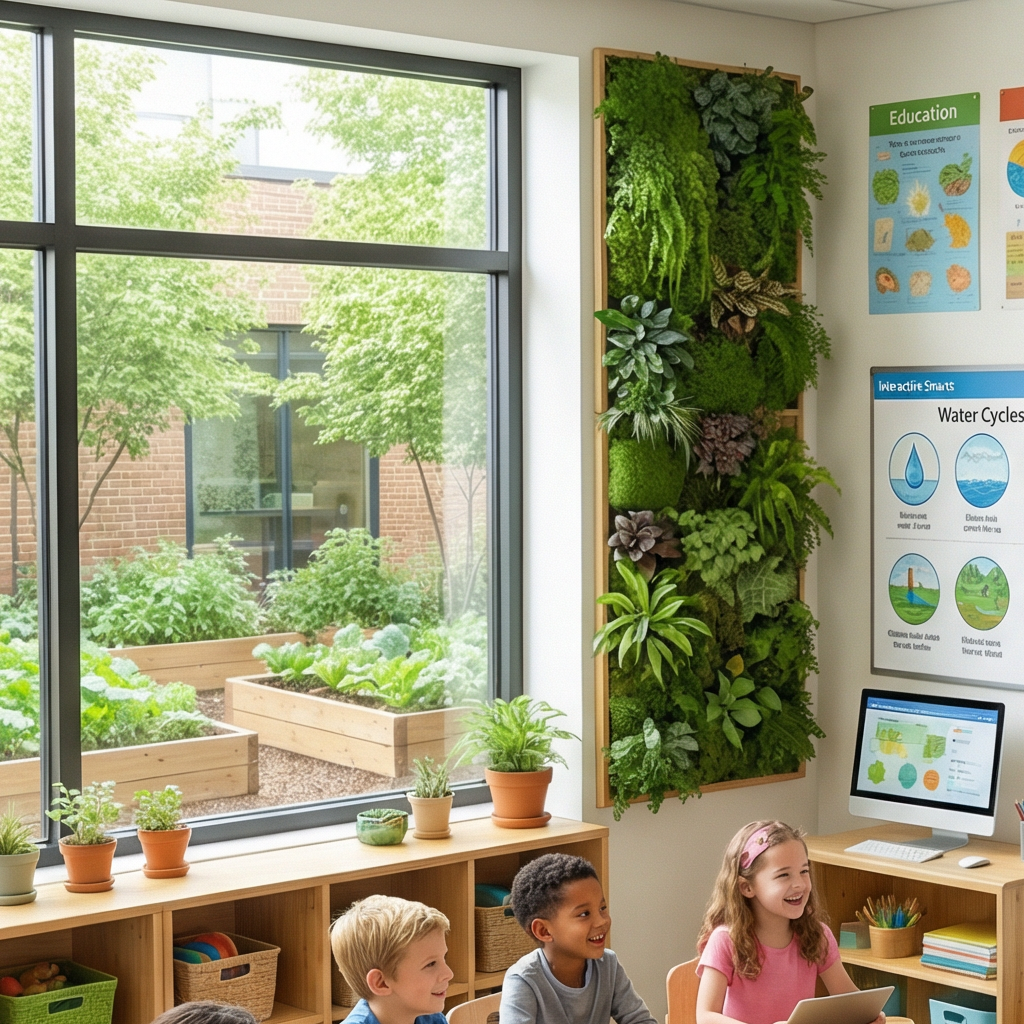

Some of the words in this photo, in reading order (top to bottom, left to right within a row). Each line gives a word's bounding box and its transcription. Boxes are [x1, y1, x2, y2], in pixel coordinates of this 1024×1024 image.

[889, 104, 957, 126] Education
[938, 407, 979, 423] Water
[981, 406, 1024, 427] Cycles
